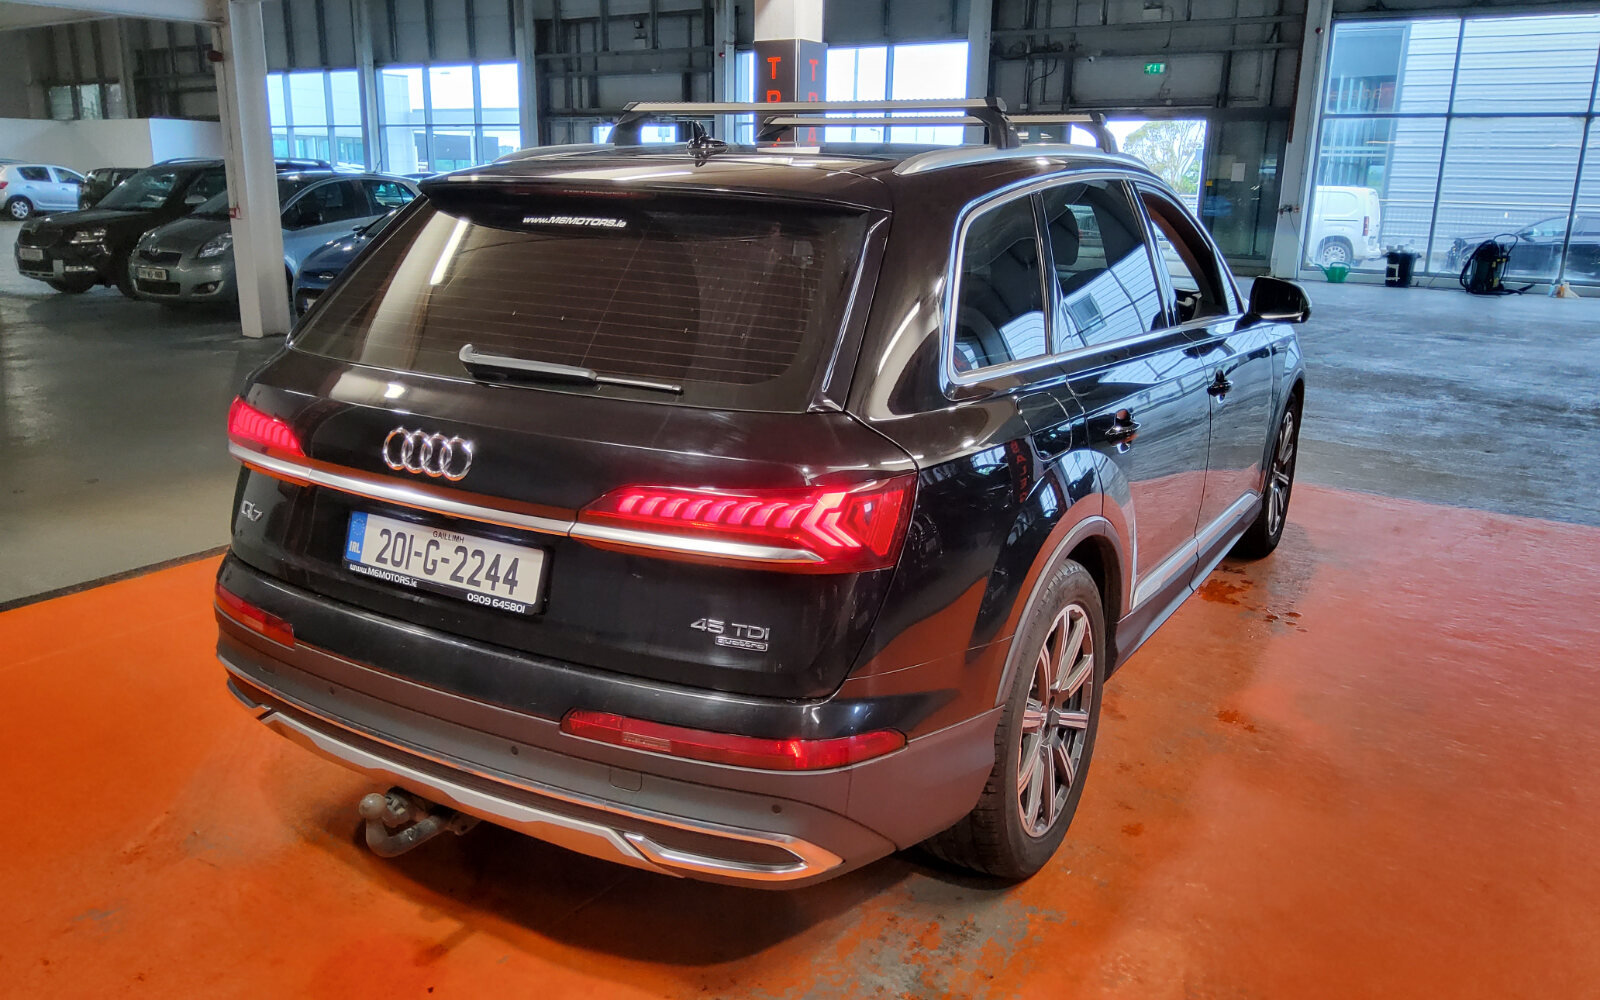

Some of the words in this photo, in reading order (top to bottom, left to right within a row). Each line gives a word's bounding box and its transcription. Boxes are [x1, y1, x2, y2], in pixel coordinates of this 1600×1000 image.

[241, 500, 263, 522] Q7
[349, 540, 361, 554] IRL
[432, 530, 465, 544] GAILLIMH
[375, 528, 520, 595] 201-G-2244
[349, 563, 418, 588] www.M6MOTORS.ie
[466, 592, 491, 605] 0909
[492, 597, 526, 614] 645801
[690, 618, 725, 634] 45
[731, 622, 770, 641] TDI
